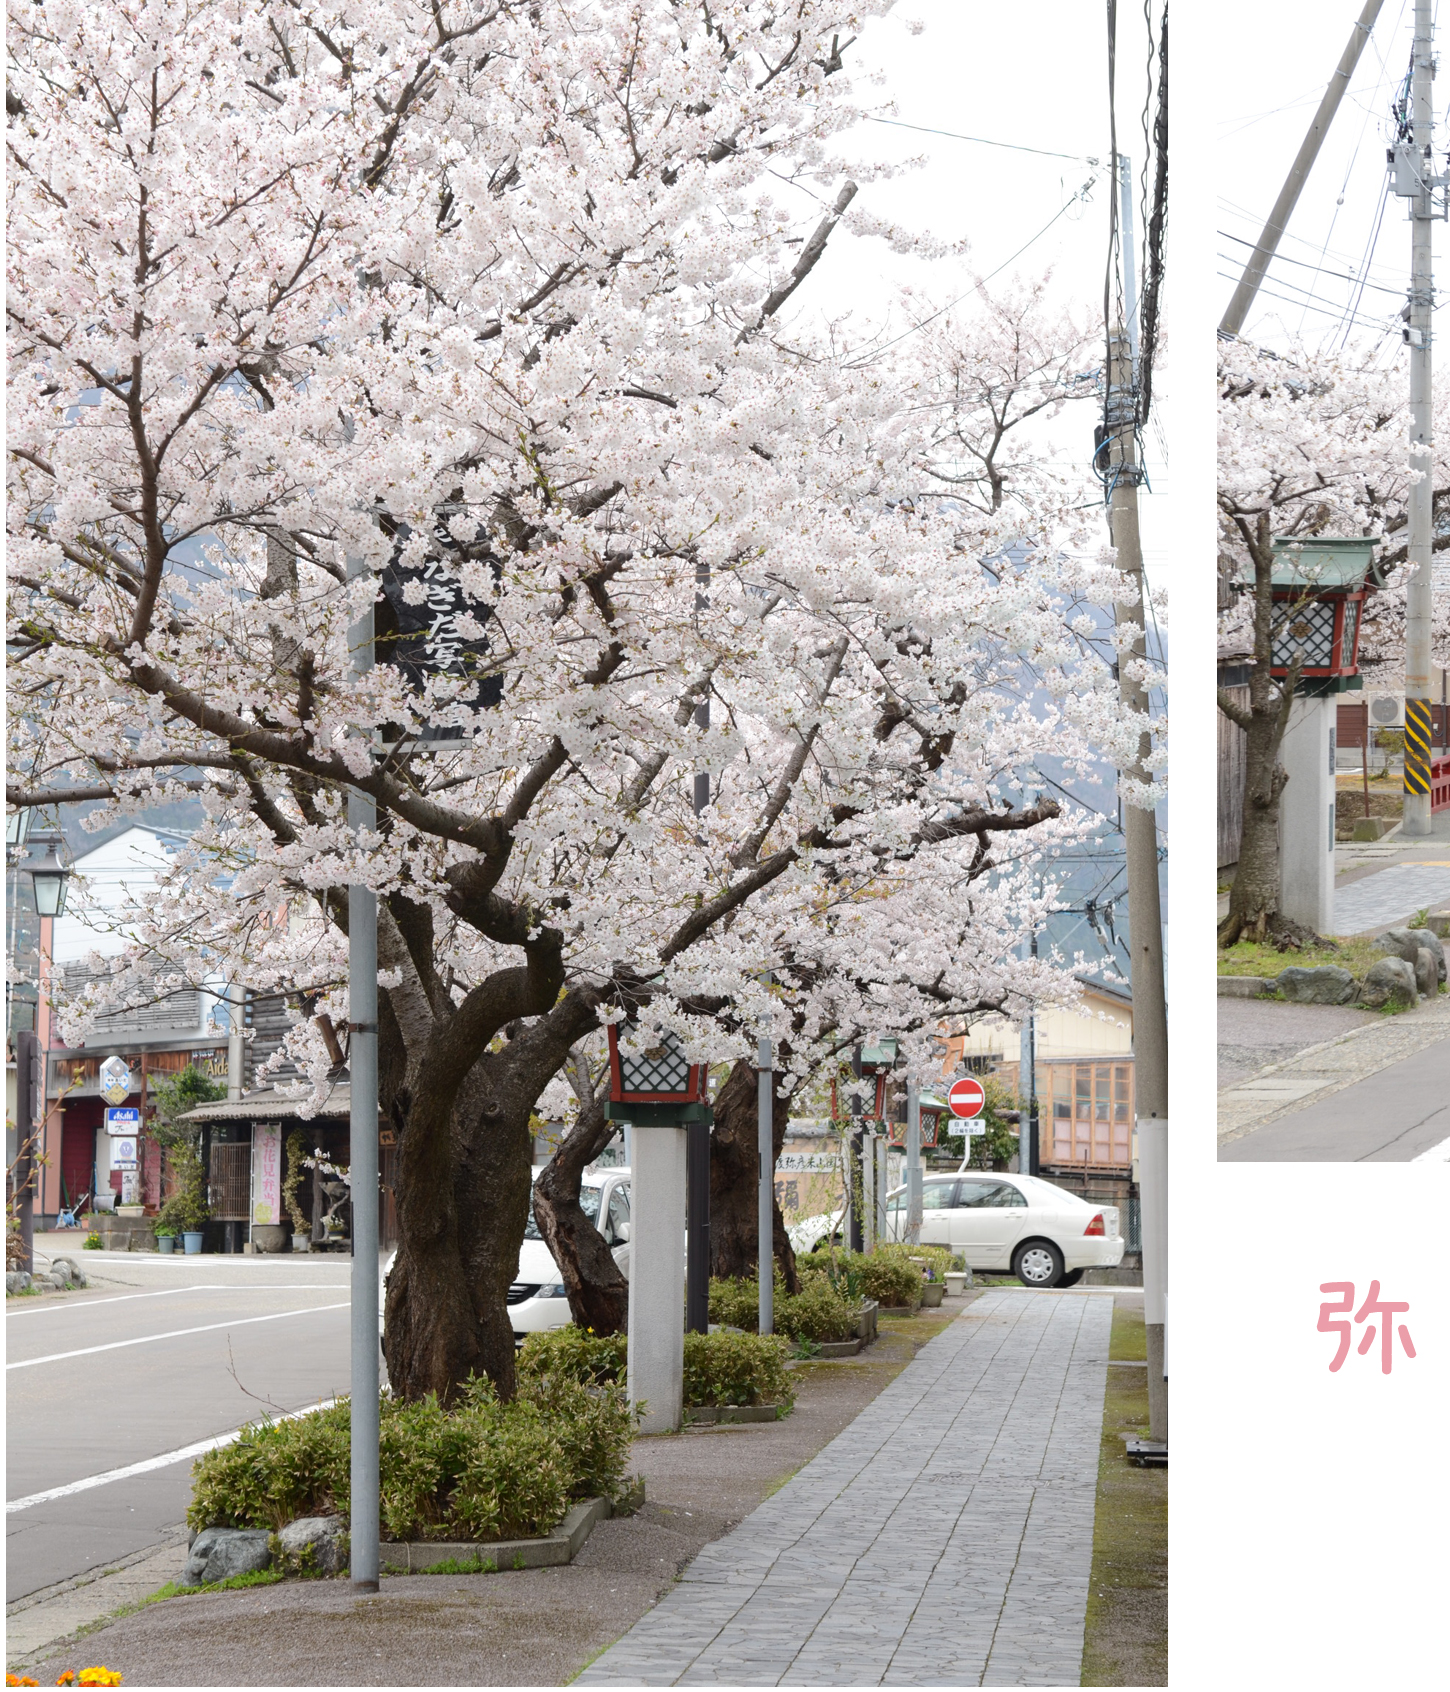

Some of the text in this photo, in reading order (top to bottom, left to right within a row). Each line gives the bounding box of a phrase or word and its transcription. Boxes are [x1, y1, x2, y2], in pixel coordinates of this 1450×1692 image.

[113, 1110, 133, 1121] Asahi
[262, 1136, 276, 1207] お花見弁当
